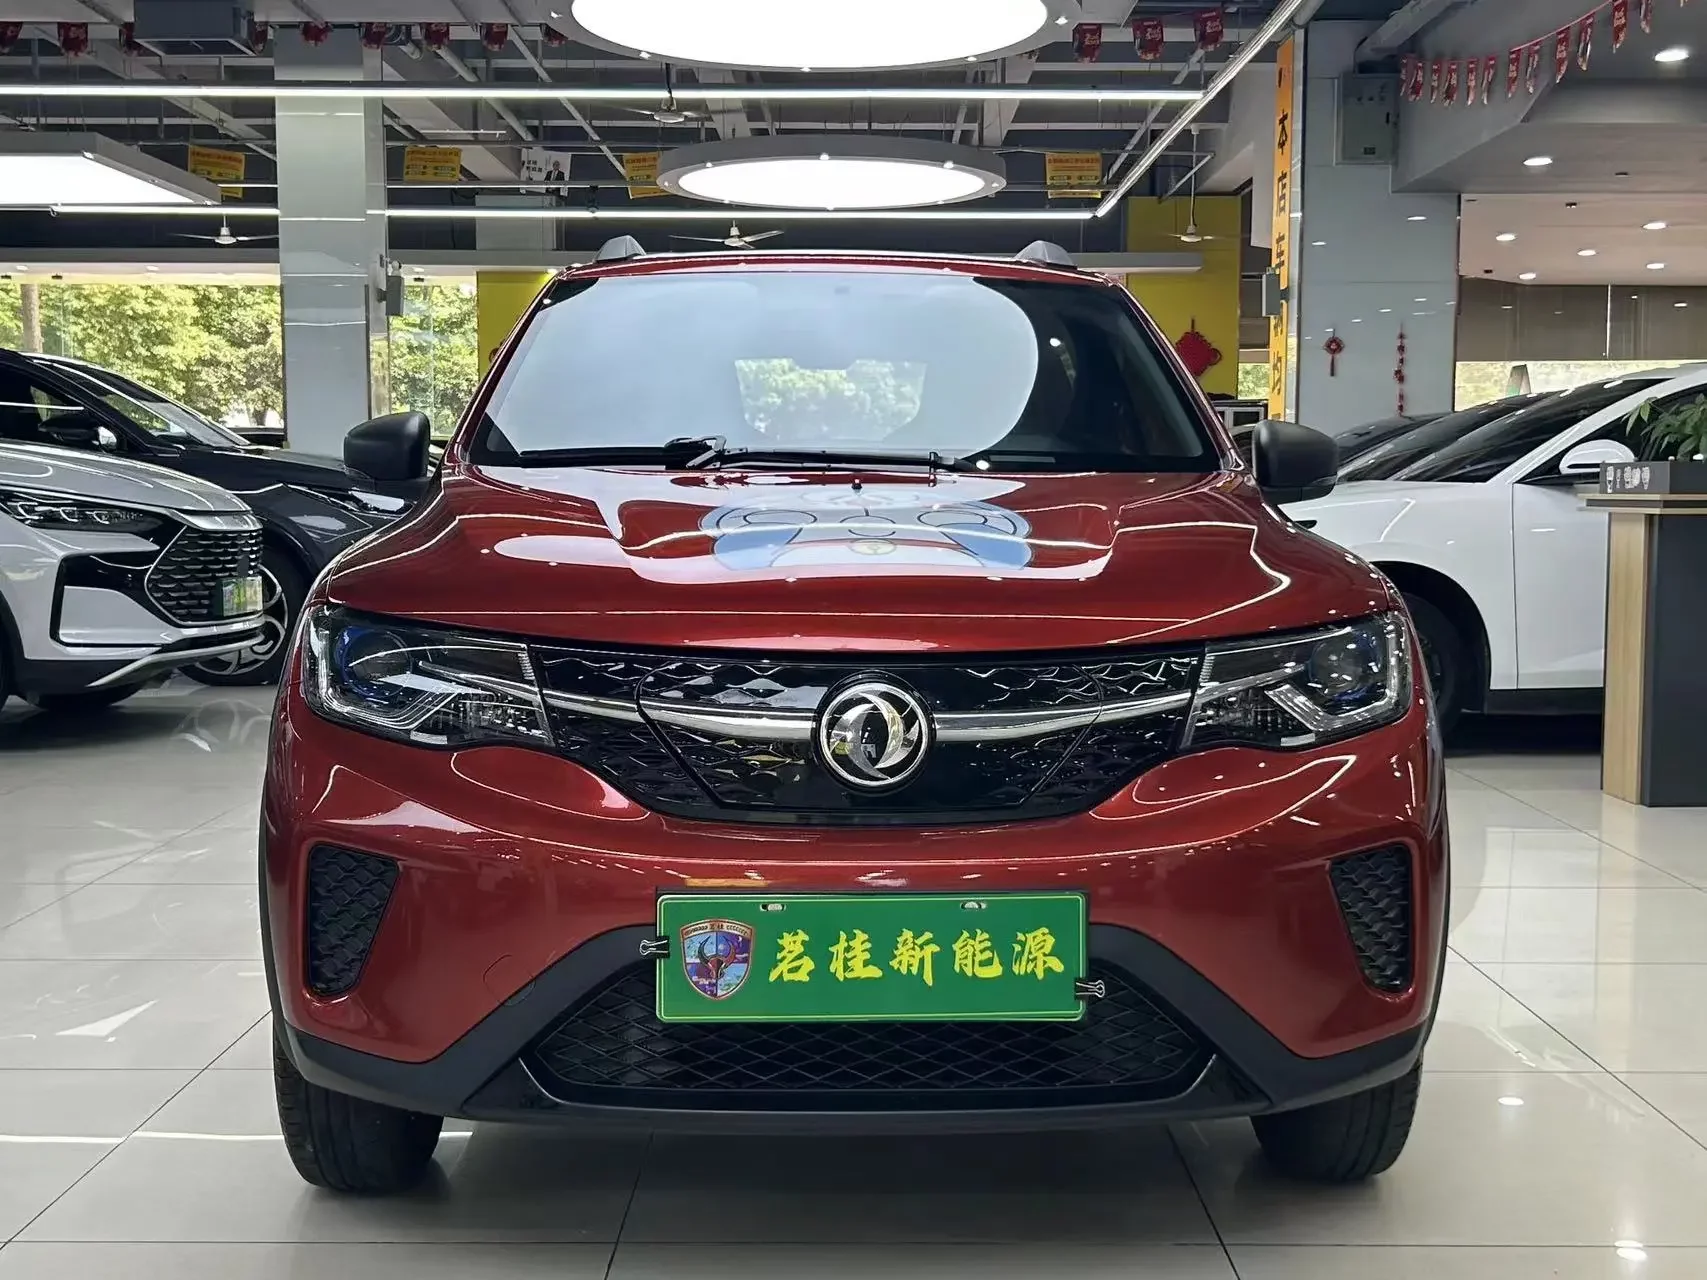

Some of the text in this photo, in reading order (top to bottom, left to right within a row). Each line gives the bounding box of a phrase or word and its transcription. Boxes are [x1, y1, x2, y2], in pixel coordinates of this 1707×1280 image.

[1271, 108, 1289, 418] 本店车均
[769, 927, 1065, 987] 茗桂新能源
